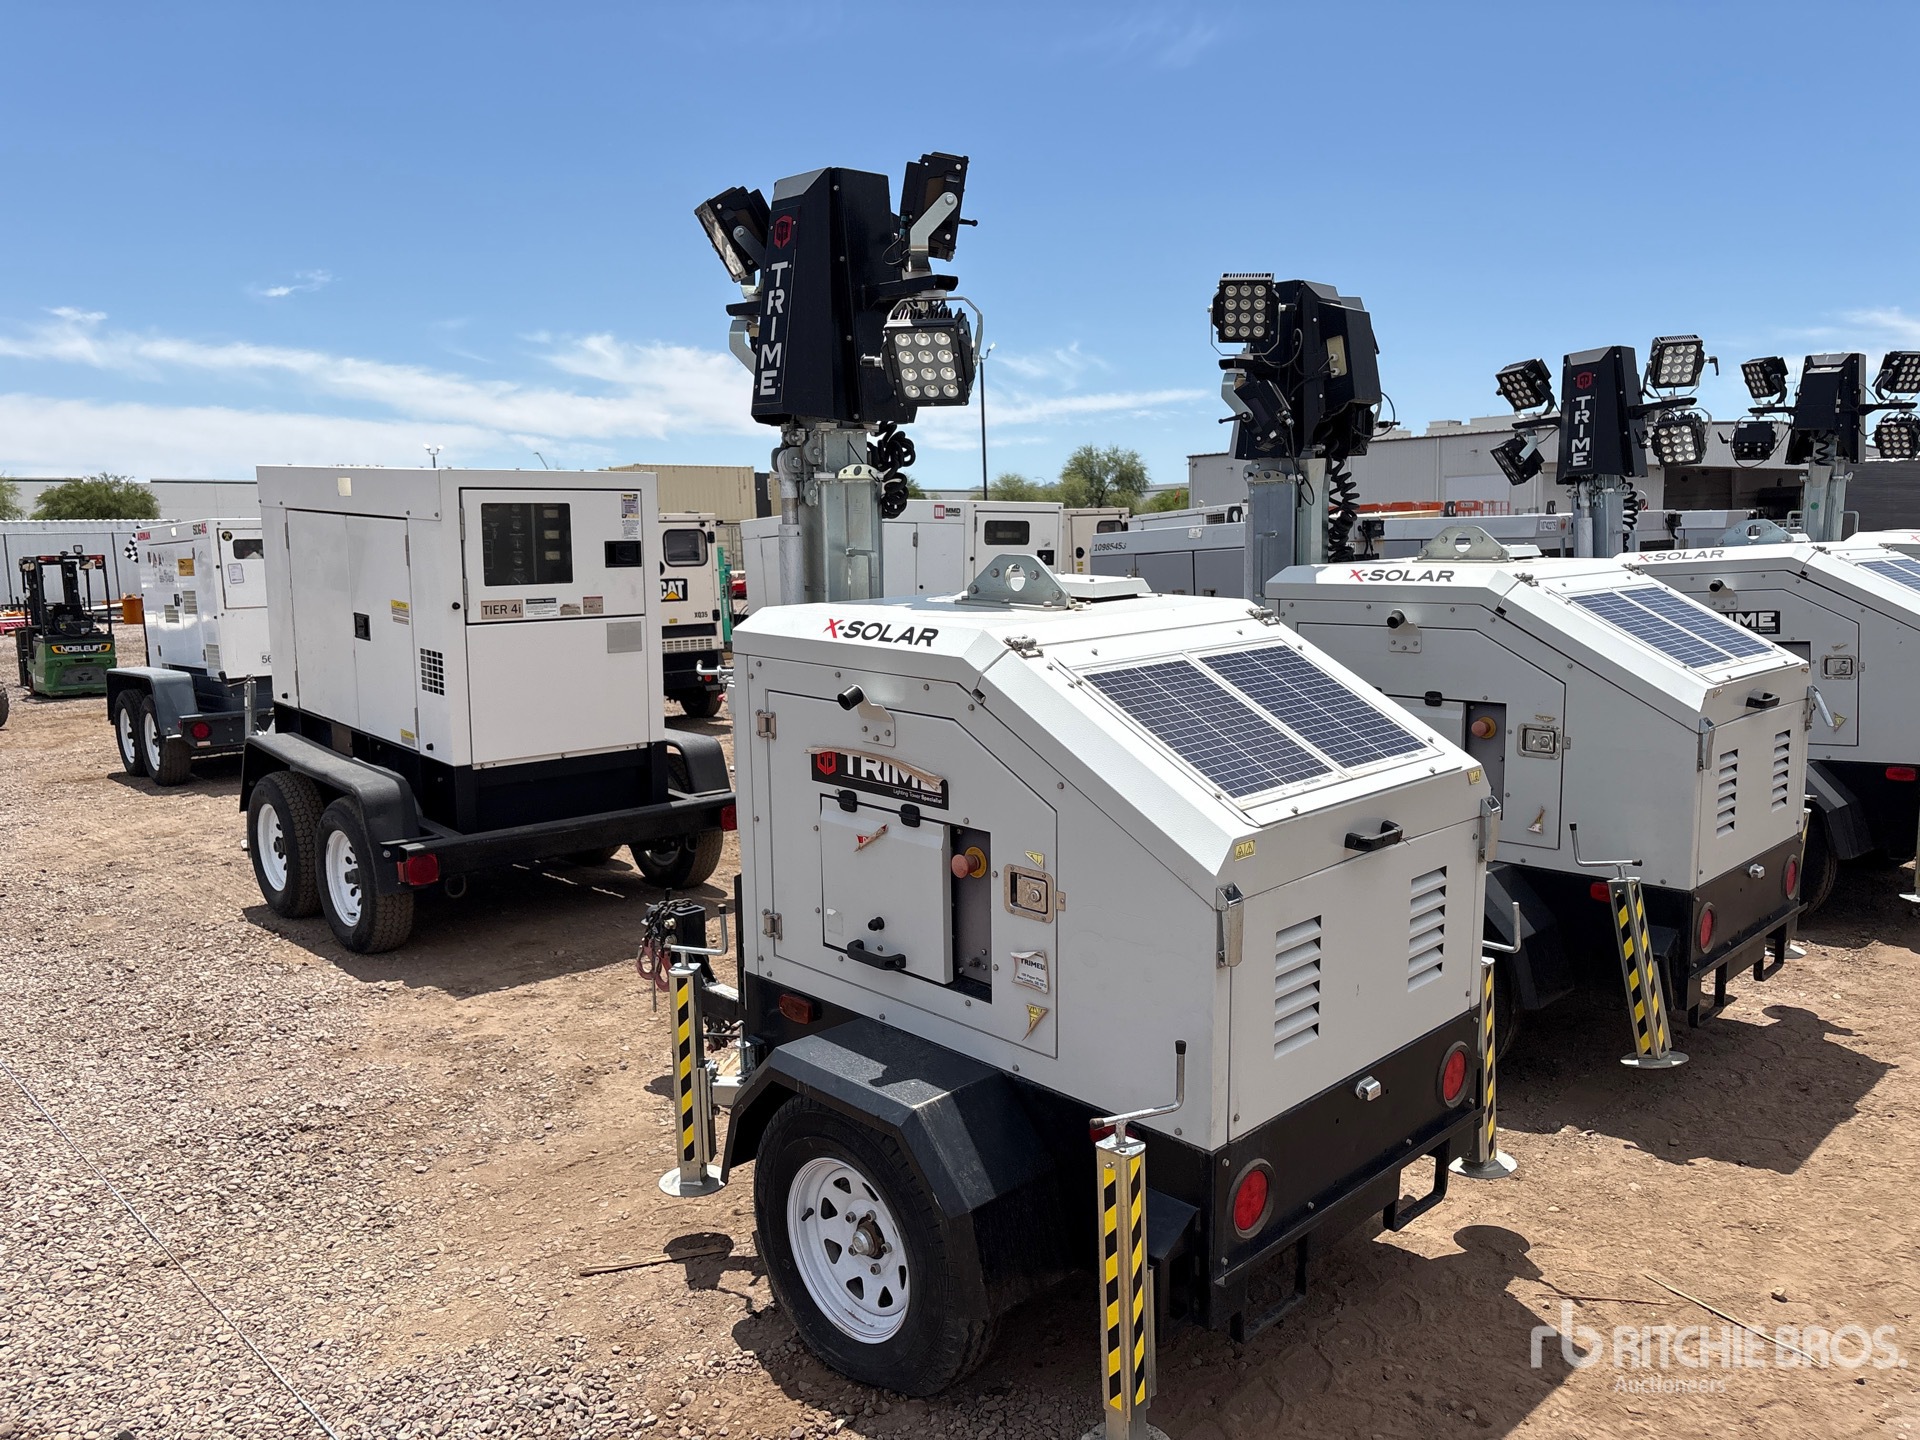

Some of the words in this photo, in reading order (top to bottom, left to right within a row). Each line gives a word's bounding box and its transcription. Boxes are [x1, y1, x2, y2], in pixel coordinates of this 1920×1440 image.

[759, 261, 789, 396] TRIME
[1571, 395, 1591, 467] TRIME
[1638, 550, 1724, 562] X-SOLAR
[1349, 569, 1455, 582] X-SOLAR
[660, 580, 685, 600] CAT
[483, 603, 508, 616] TIER
[823, 618, 939, 647] X-SOLAR
[60, 644, 103, 653] NOBLELIFT
[893, 788, 909, 798] Lighting
